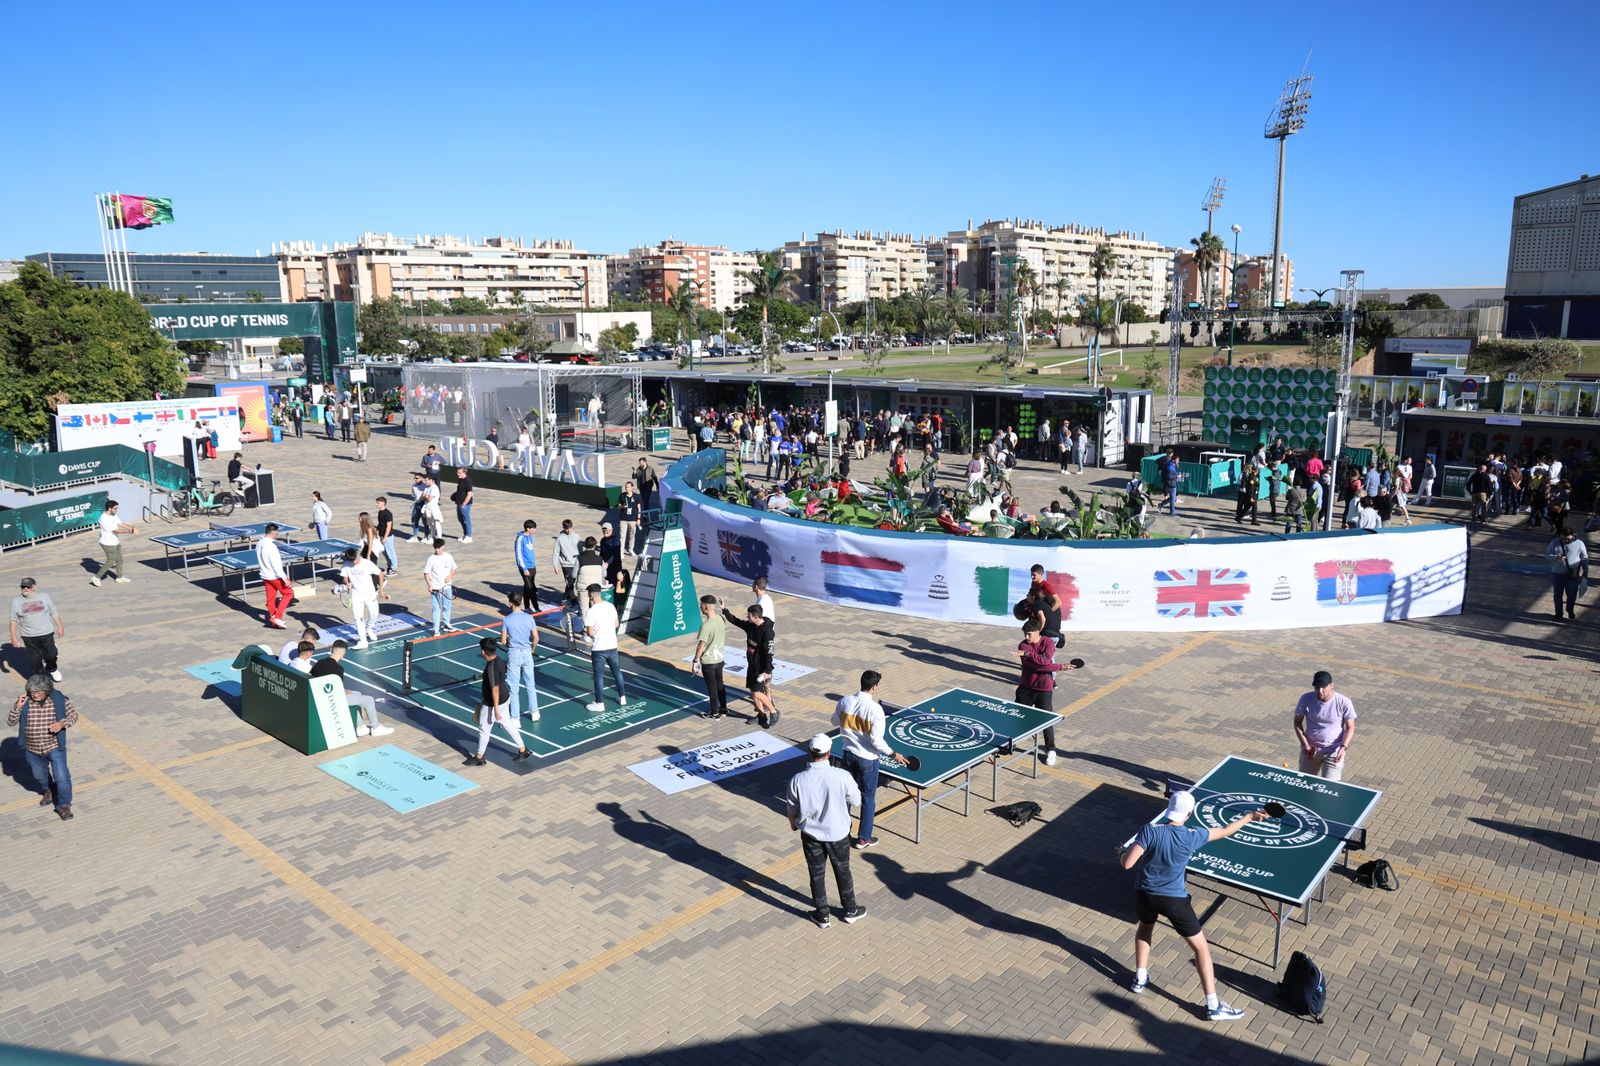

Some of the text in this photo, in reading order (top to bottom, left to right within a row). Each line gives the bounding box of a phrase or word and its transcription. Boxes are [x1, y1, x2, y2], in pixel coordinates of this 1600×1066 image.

[150, 313, 289, 328] ORLD CUP OF TENNIS
[67, 463, 87, 471] DAVIS
[46, 502, 91, 517] THE WORLD CUP
[64, 511, 85, 520] TENNIS
[671, 553, 684, 591] Camps
[673, 590, 683, 600] &
[673, 601, 687, 630] Juvé
[251, 661, 297, 691] THE WORLD CUP
[258, 677, 289, 700] OF TENNIS
[327, 694, 344, 739] DAVIS CUP
[560, 701, 648, 731] THE WORLD CUP
[585, 709, 645, 730] OF TENNIS
[909, 739, 930, 747] CUP
[662, 741, 756, 770] FINALS 2023
[676, 749, 771, 780] FINALS 2023
[1248, 771, 1339, 797] THE WORLD CUP
[1266, 771, 1307, 784] TENNIS
[1285, 805, 1319, 826] FINALS
[1233, 832, 1261, 843] CUP
[1264, 838, 1281, 846] OF
[1282, 829, 1319, 845] TENNIS
[1198, 852, 1275, 878] WORLD CUP
[1202, 859, 1251, 878] TENNIS
